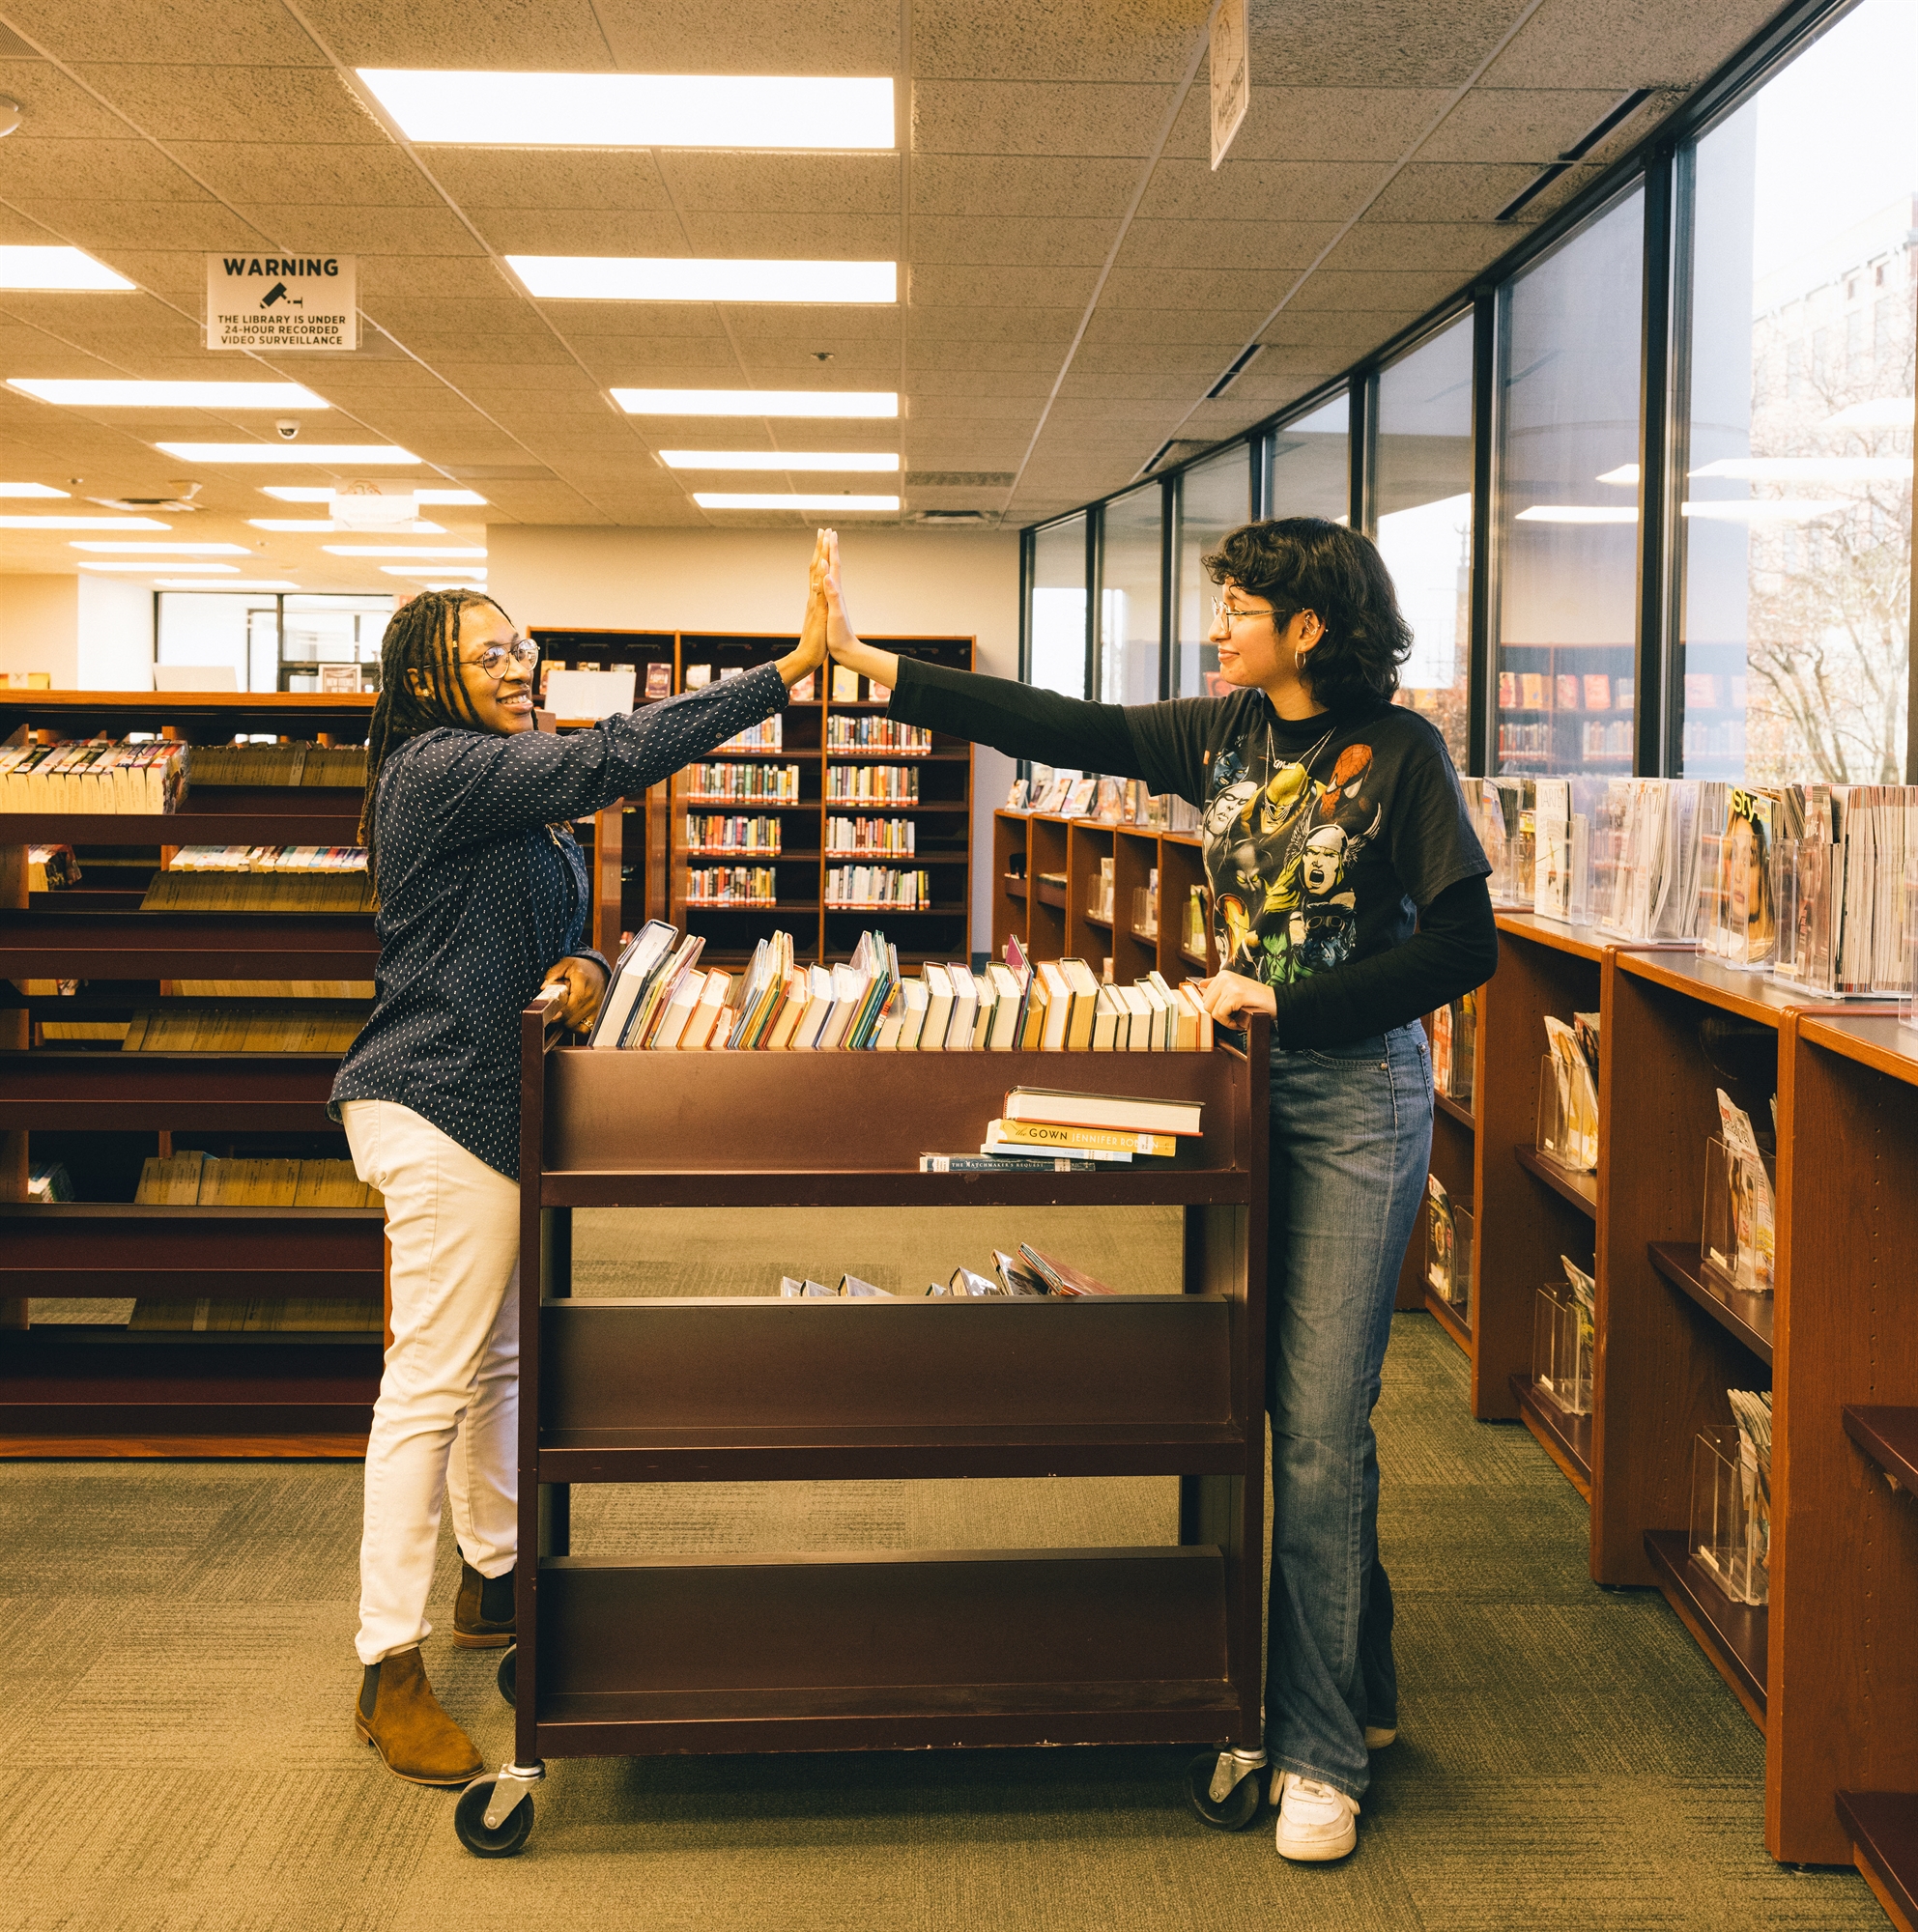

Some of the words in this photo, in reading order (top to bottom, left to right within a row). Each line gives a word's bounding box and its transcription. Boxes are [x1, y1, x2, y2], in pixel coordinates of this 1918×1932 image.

[222, 258, 339, 276] WARNING
[217, 315, 239, 324] THE
[243, 315, 291, 324] LIBRARY
[307, 316, 346, 325] UNDER
[224, 326, 275, 334] 24-HOUR
[278, 326, 339, 334] RECORDED
[220, 335, 255, 345] VIDEO
[259, 335, 343, 345] SURVEILLANCE
[1029, 1127, 1068, 1141] GOWN
[1072, 1132, 1118, 1146] JENNIFER
[1120, 1137, 1159, 1150] ROBN
